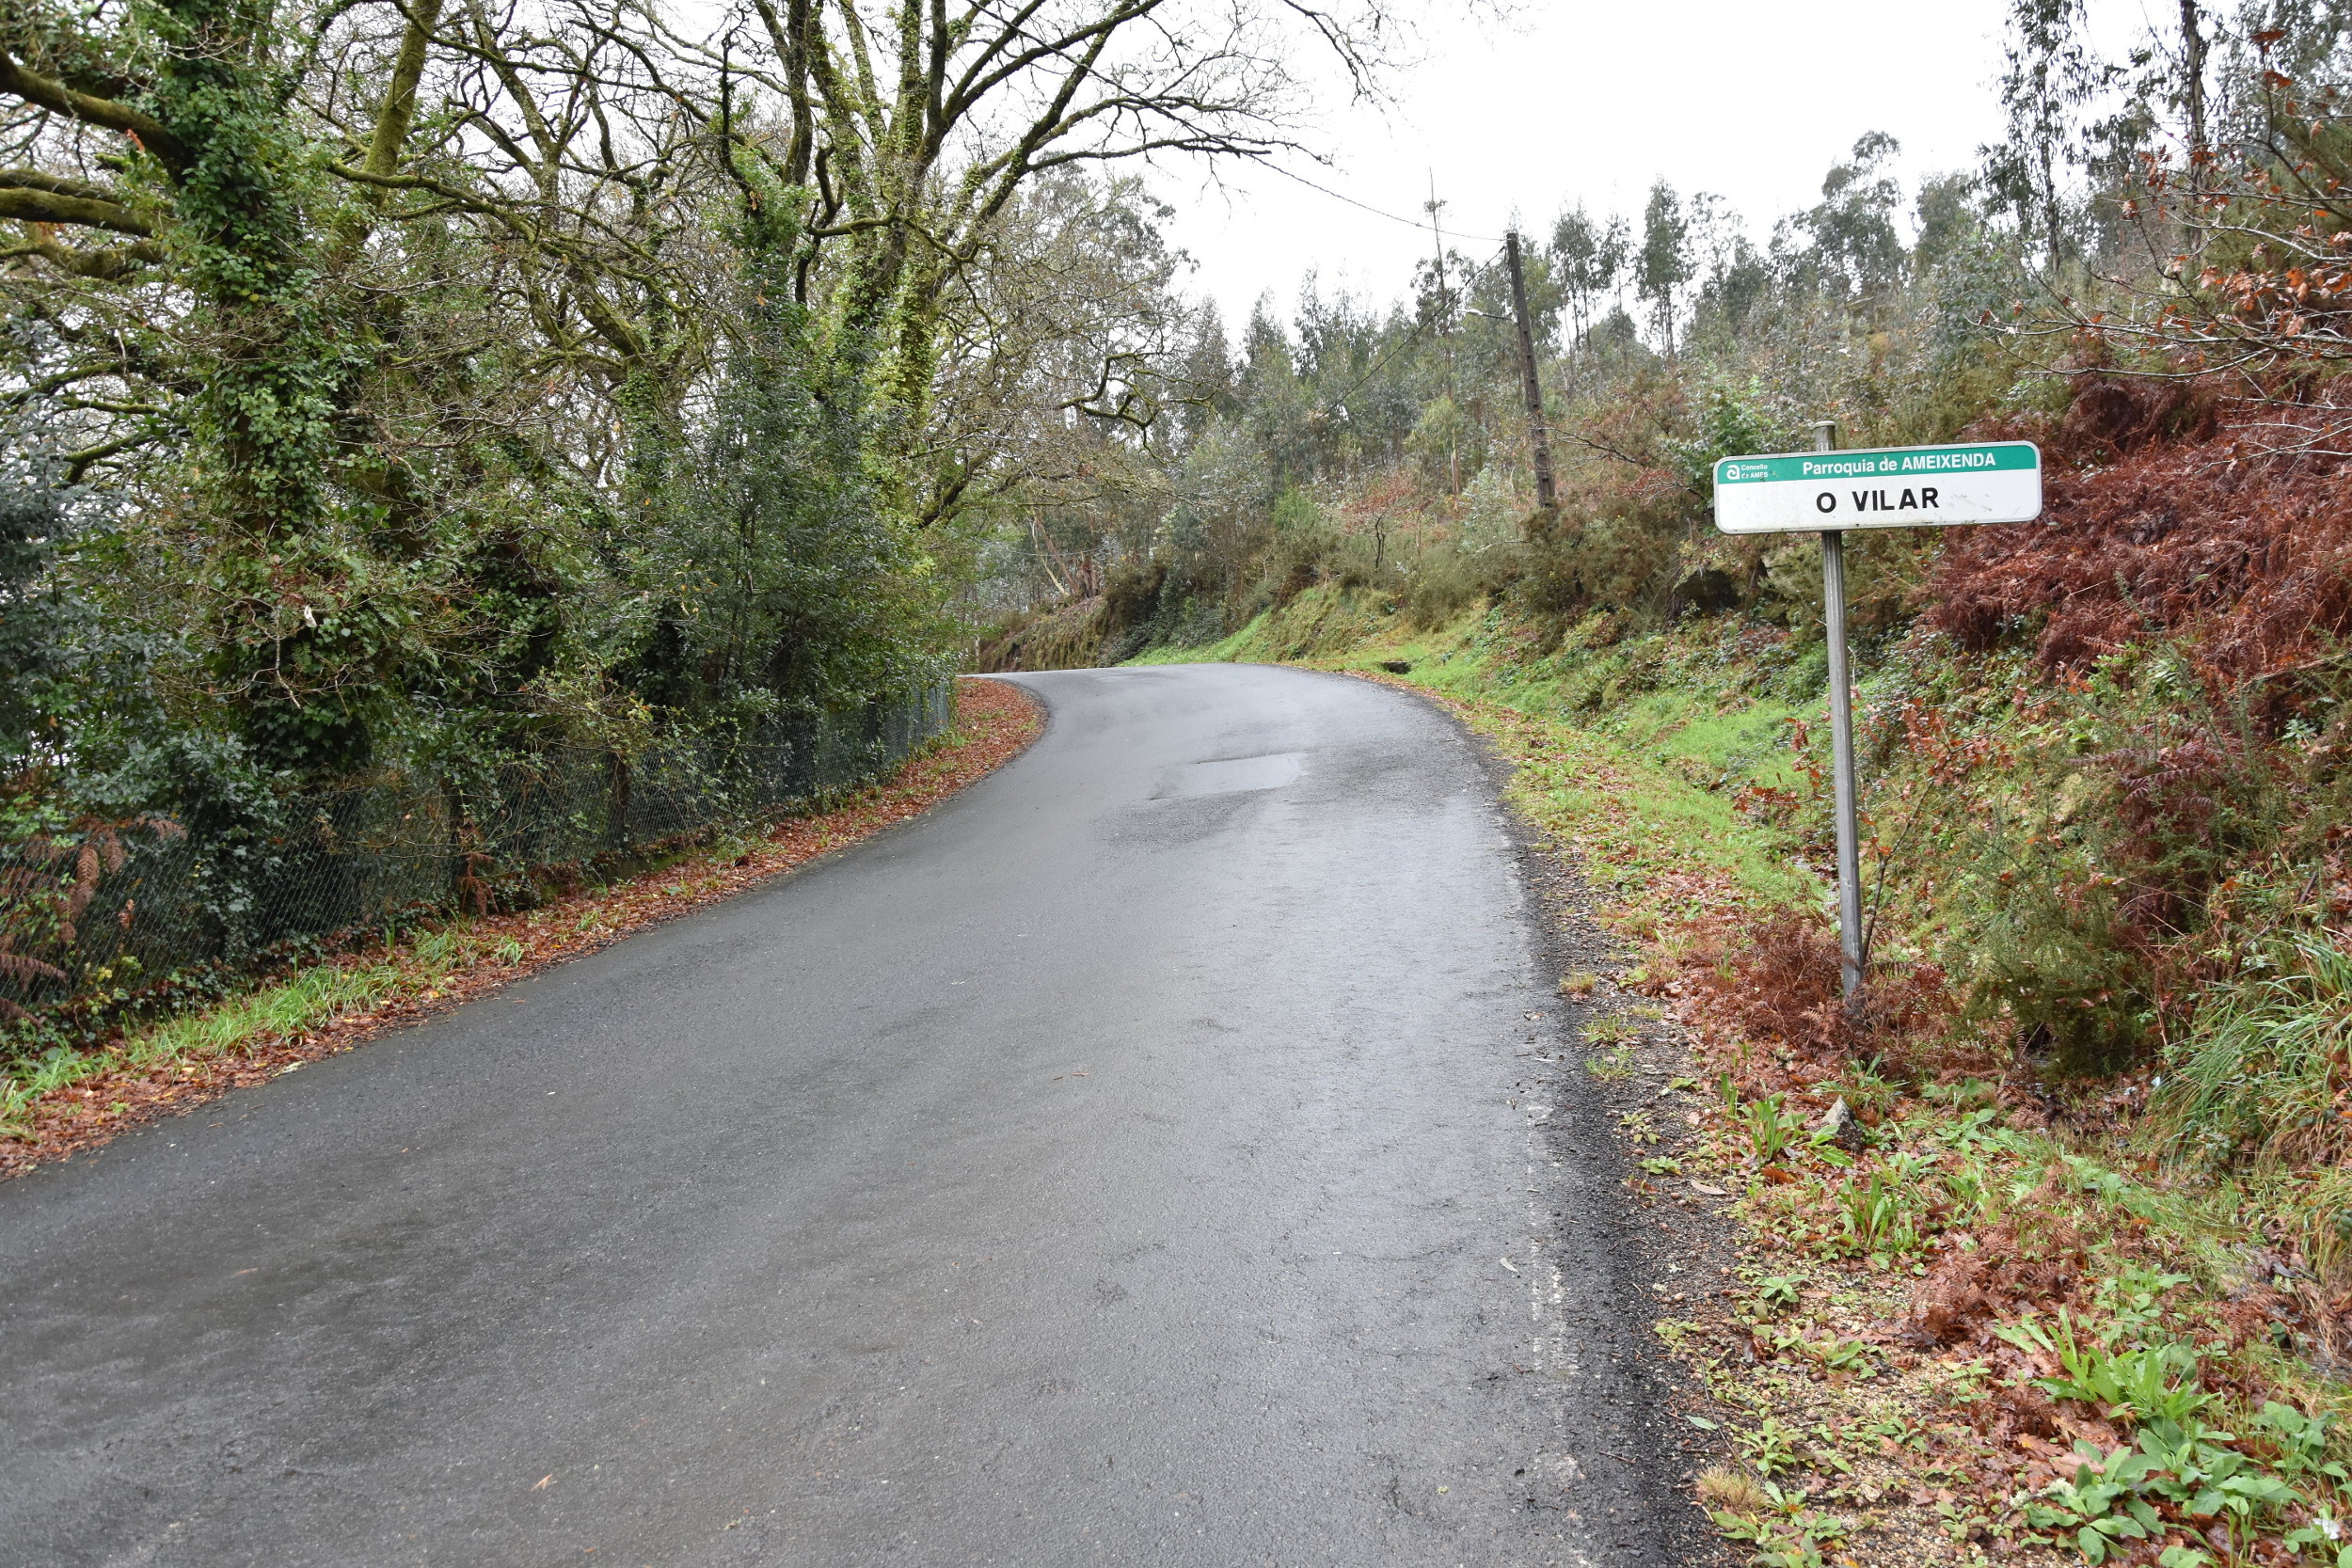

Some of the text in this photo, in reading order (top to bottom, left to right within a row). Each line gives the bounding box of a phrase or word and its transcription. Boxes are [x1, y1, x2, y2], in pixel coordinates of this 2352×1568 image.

[1803, 453, 1996, 476] Parroquia de AMEIXENDA
[1816, 487, 1940, 513] O VILAR
